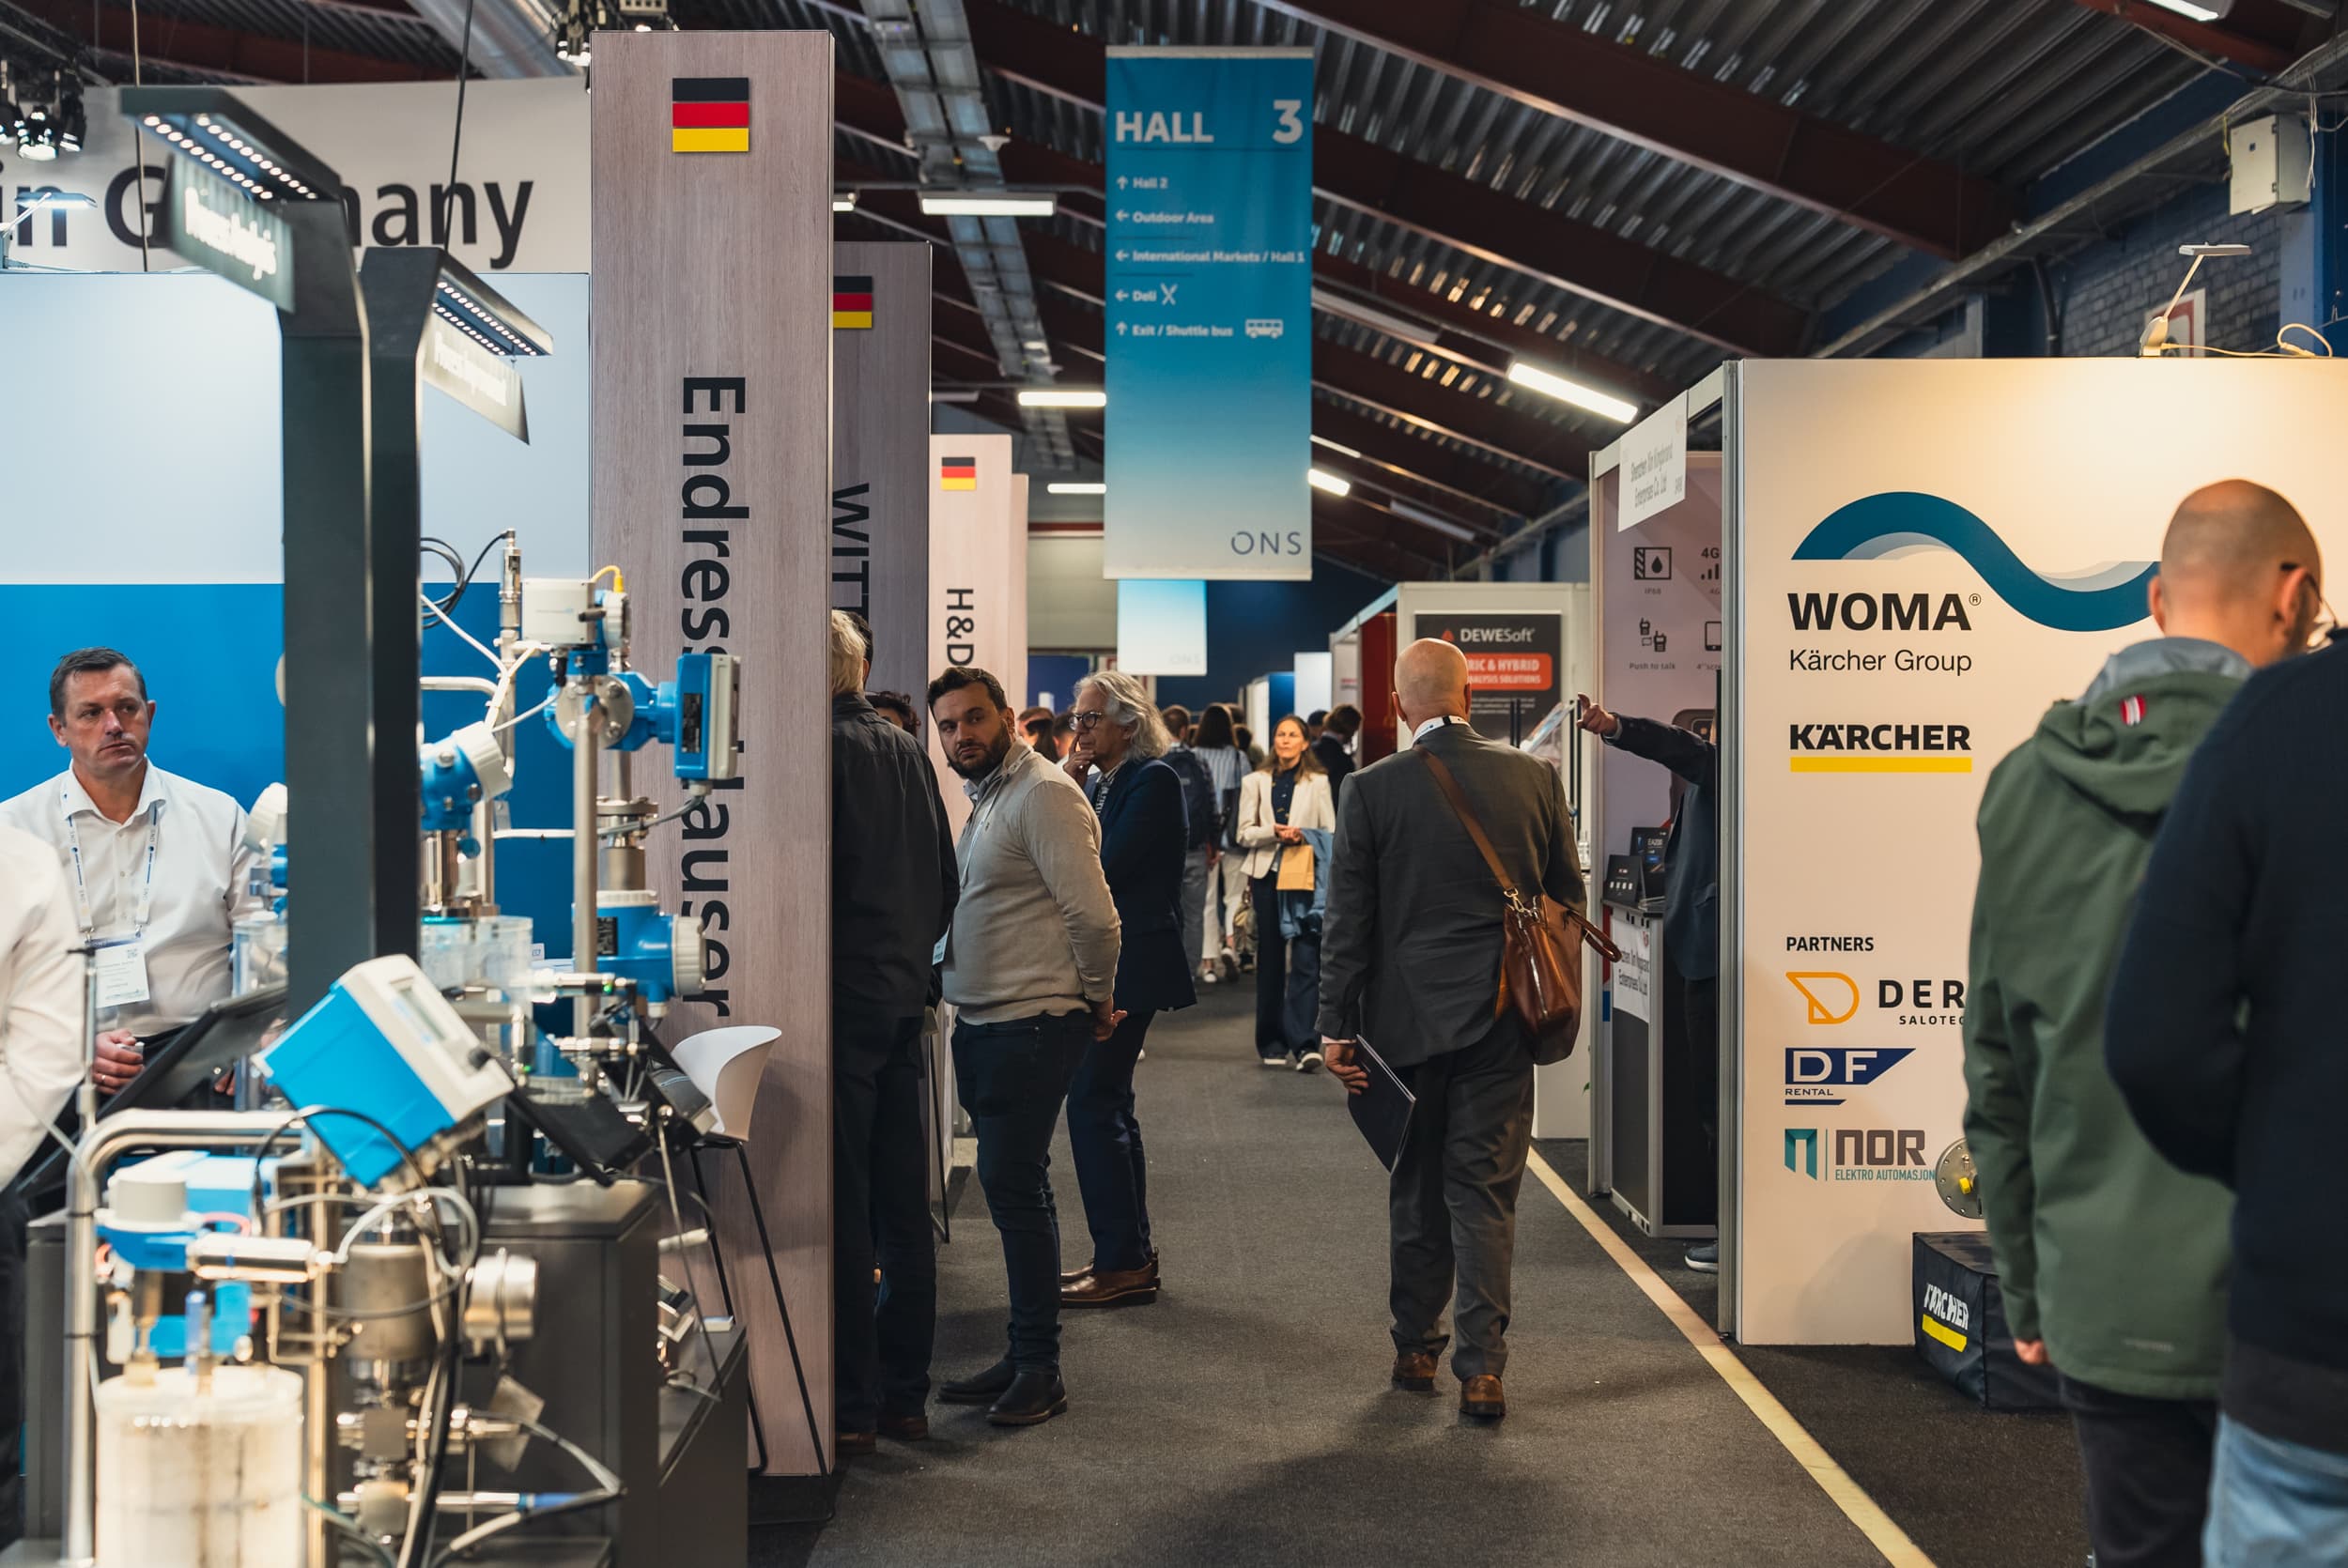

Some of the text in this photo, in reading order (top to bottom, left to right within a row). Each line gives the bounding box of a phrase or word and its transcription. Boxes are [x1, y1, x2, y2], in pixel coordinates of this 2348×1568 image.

[1115, 99, 1304, 144] HALL 3
[1133, 177, 1168, 189] Hall 2
[104, 165, 533, 270] Gany
[1133, 211, 1214, 223] Outdoor Area
[1133, 250, 1210, 263] International
[1213, 251, 1259, 263] Markets
[1271, 251, 1295, 263] Hall
[1297, 251, 1305, 263] 1
[1133, 290, 1156, 301] Deli
[1133, 325, 1155, 337] Exit
[1166, 325, 1209, 337] Shuttle
[1211, 326, 1233, 337] bus
[1230, 531, 1302, 555] ONS
[1701, 547, 1720, 559] 4G
[1460, 628, 1533, 642] DEWESoft
[1498, 659, 1540, 671] HYBRID
[1790, 649, 1972, 676] Kärcher Group
[1790, 724, 1971, 750] KÄRCHER
[1785, 936, 1875, 952] PARTNERS
[1793, 1051, 1877, 1083] DF
[1835, 1169, 1936, 1181] ELEKTRO AUTOMASJON
